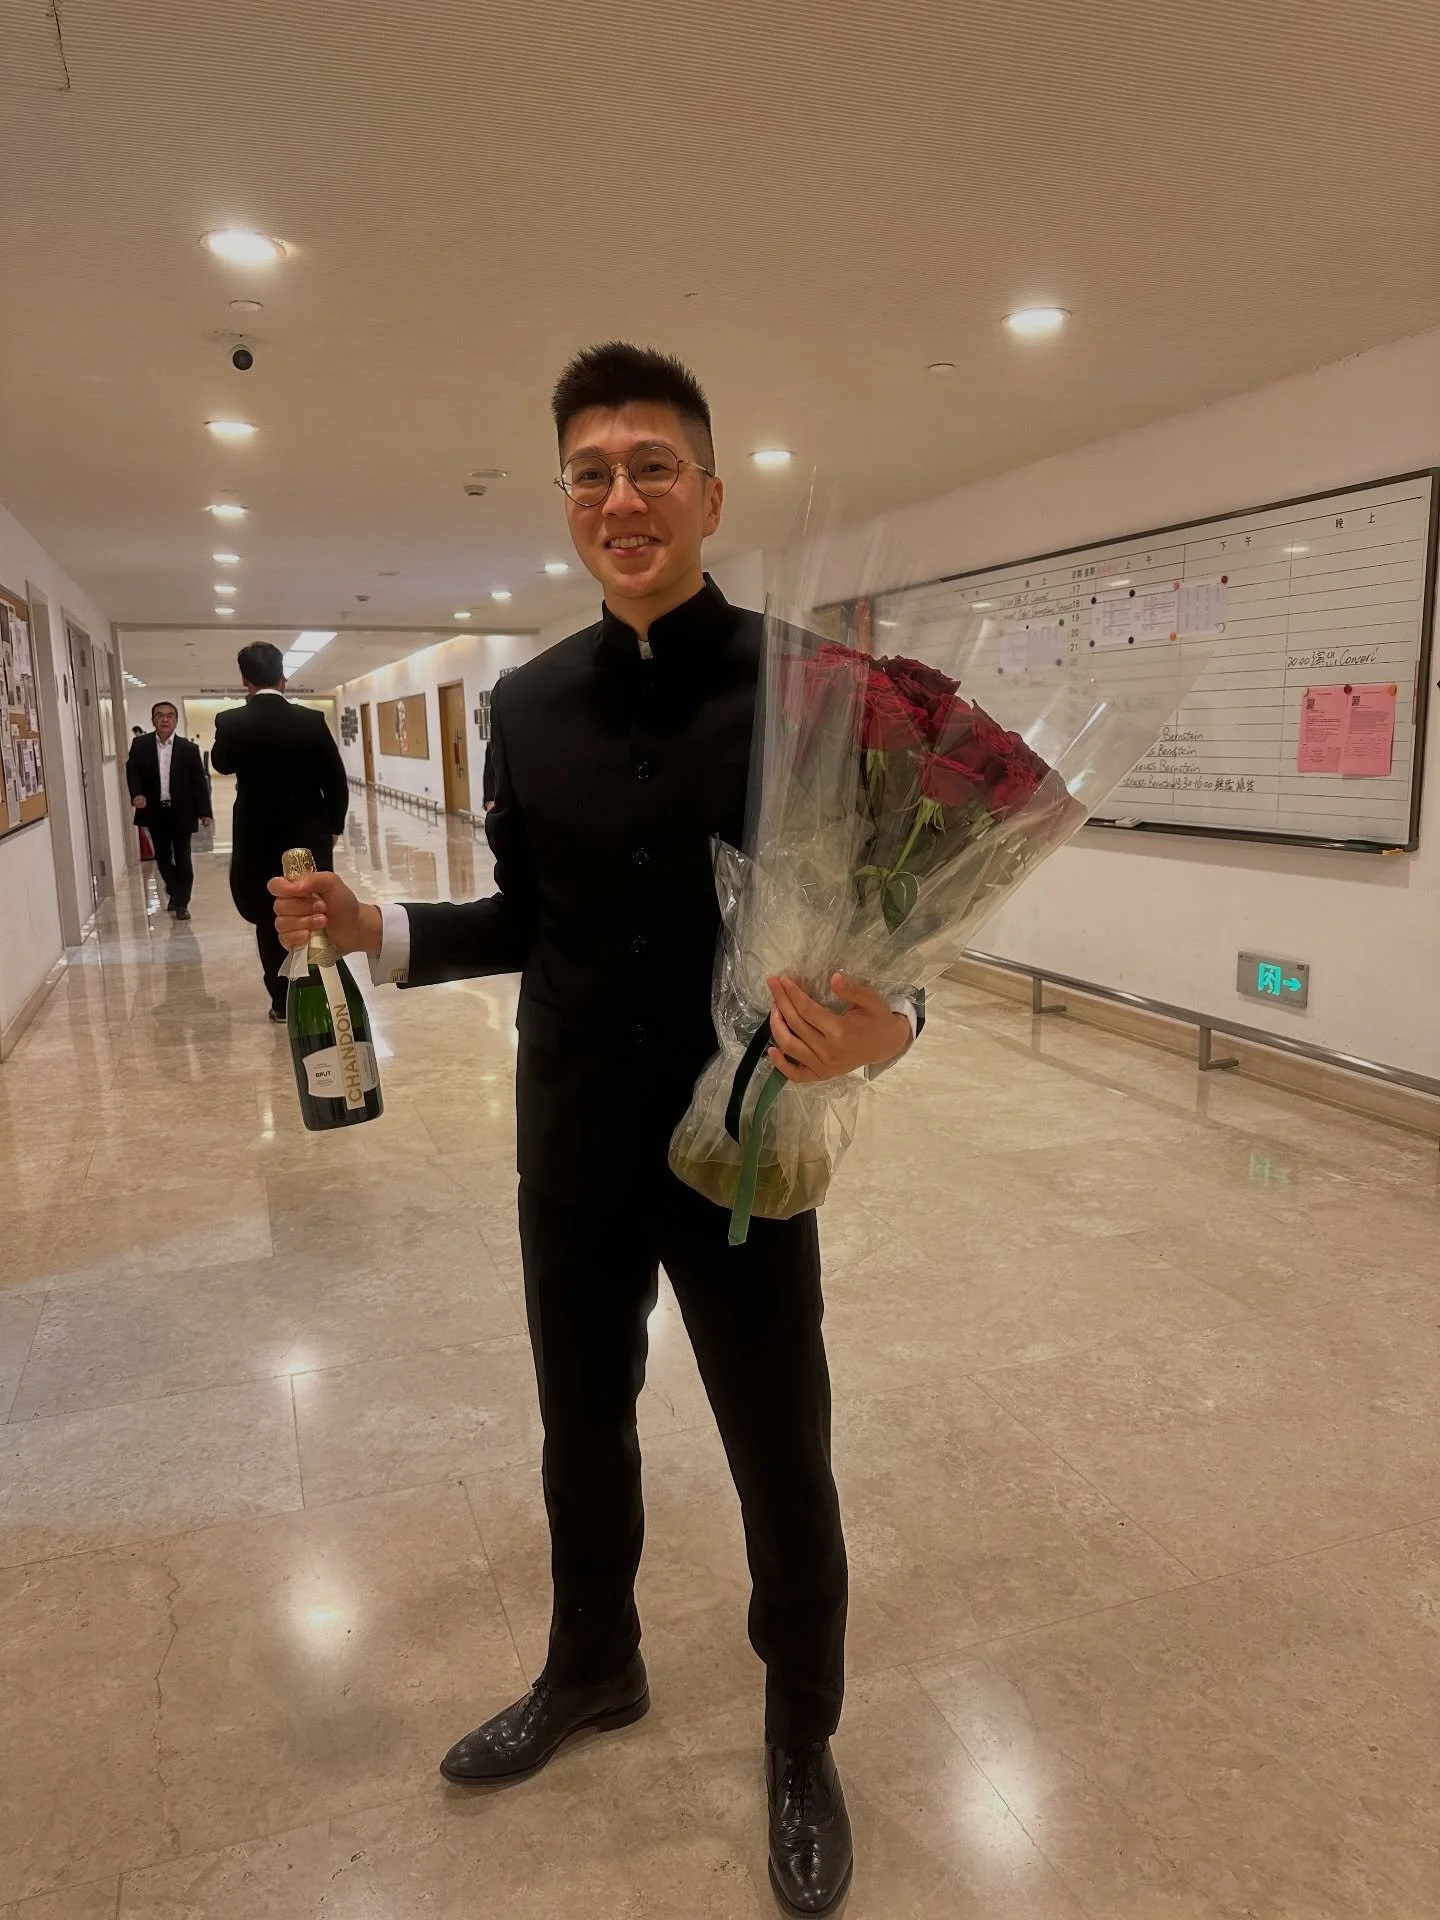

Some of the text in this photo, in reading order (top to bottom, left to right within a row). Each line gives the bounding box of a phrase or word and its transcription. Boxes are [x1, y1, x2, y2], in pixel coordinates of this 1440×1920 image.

[1072, 600, 1080, 608] 18
[1072, 614, 1079, 622] 19
[1071, 628, 1079, 637] 20
[1070, 643, 1078, 652] 21
[333, 1003, 363, 1102] CHANDON
[315, 1070, 331, 1078] BRUT
